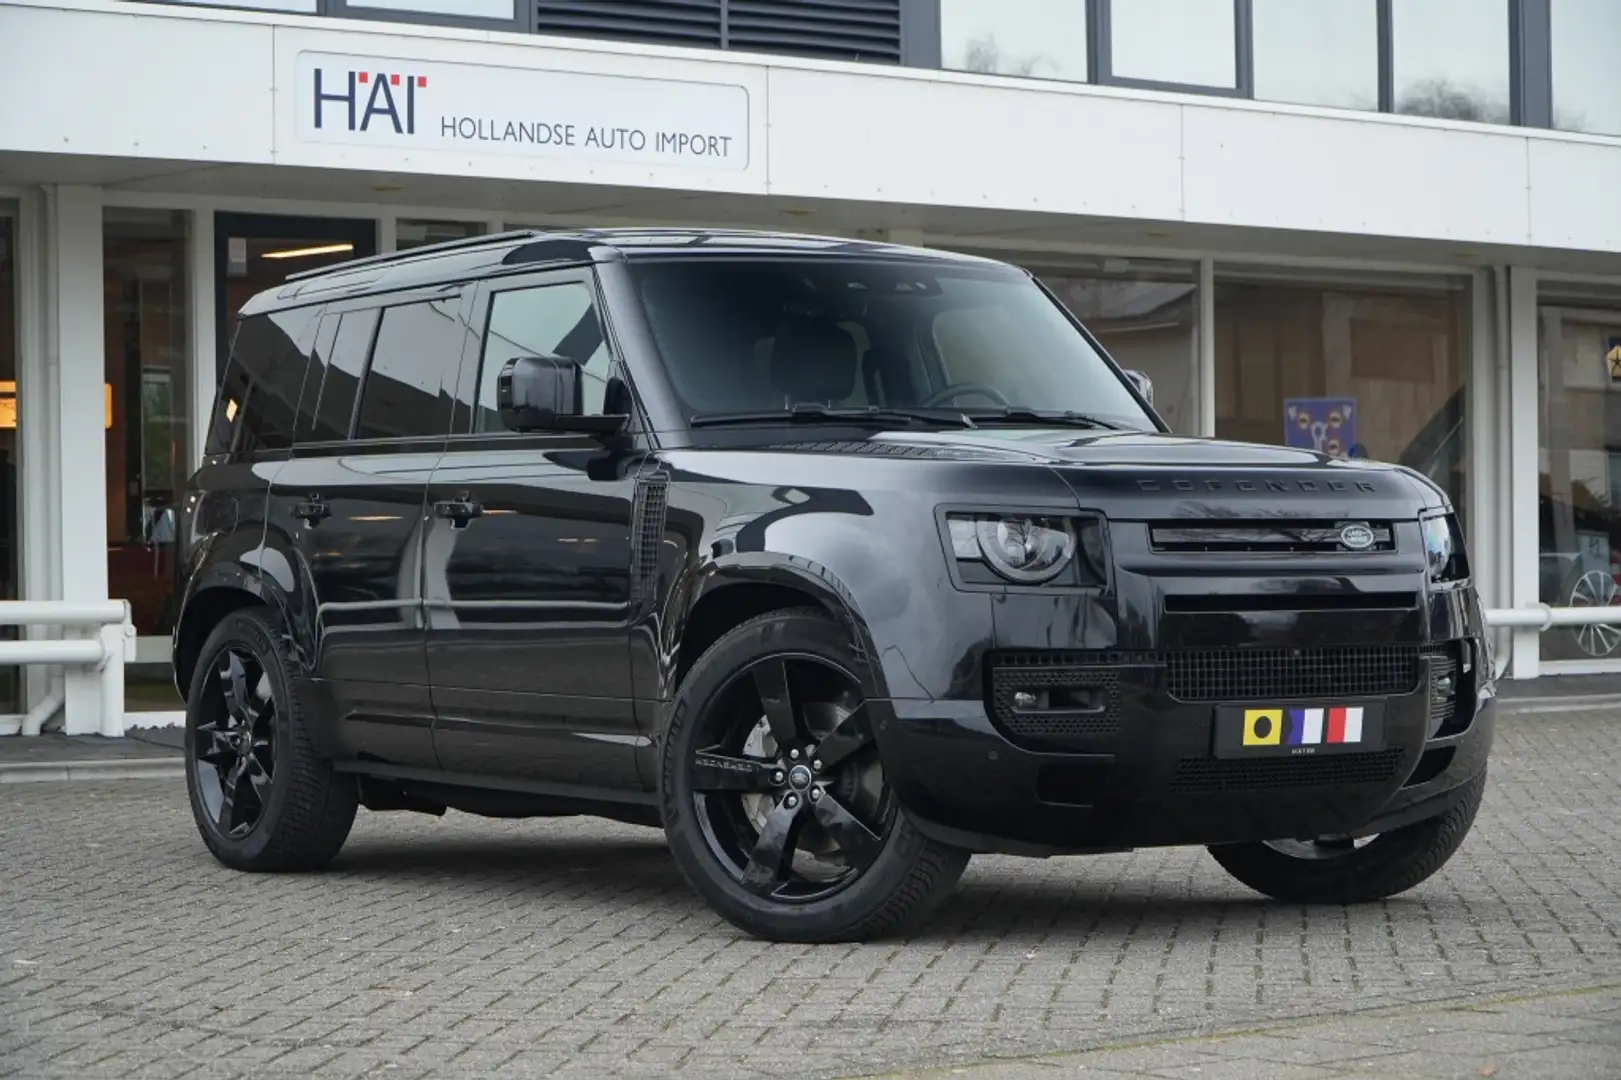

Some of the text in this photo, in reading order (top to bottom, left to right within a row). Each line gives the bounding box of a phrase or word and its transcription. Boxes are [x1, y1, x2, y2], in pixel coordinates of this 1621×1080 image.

[441, 115, 733, 158] HOLLANDSE AUTO IMPORT
[1136, 479, 1377, 493] DEFENDER
